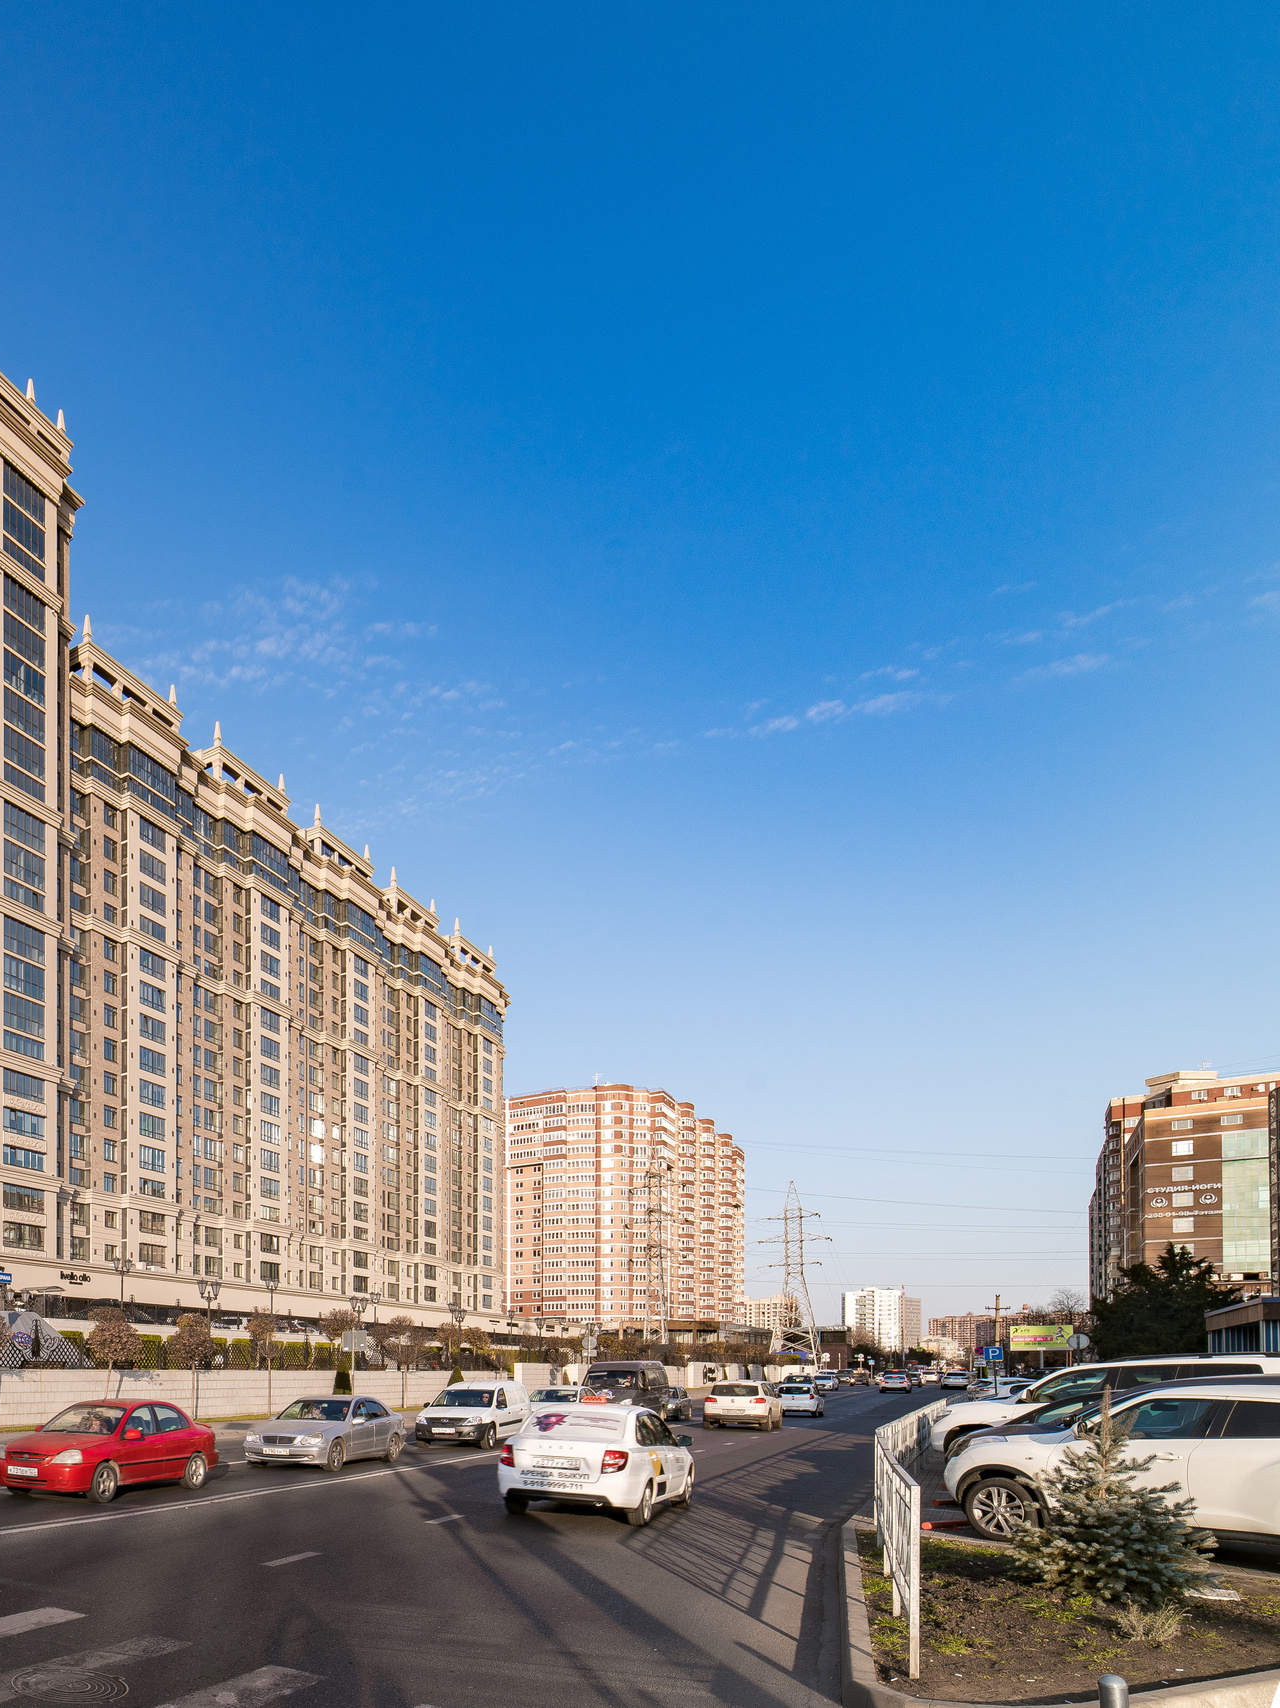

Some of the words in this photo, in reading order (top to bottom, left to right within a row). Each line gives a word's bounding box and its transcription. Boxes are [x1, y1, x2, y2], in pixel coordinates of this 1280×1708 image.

[1147, 1185, 1189, 1193] СТУДИЯ
[1191, 1183, 1222, 1191] ЙОГИ
[989, 1348, 1000, 1360] P
[520, 1469, 554, 1478] АРЕНДА
[558, 1471, 590, 1480] ВЫКУП
